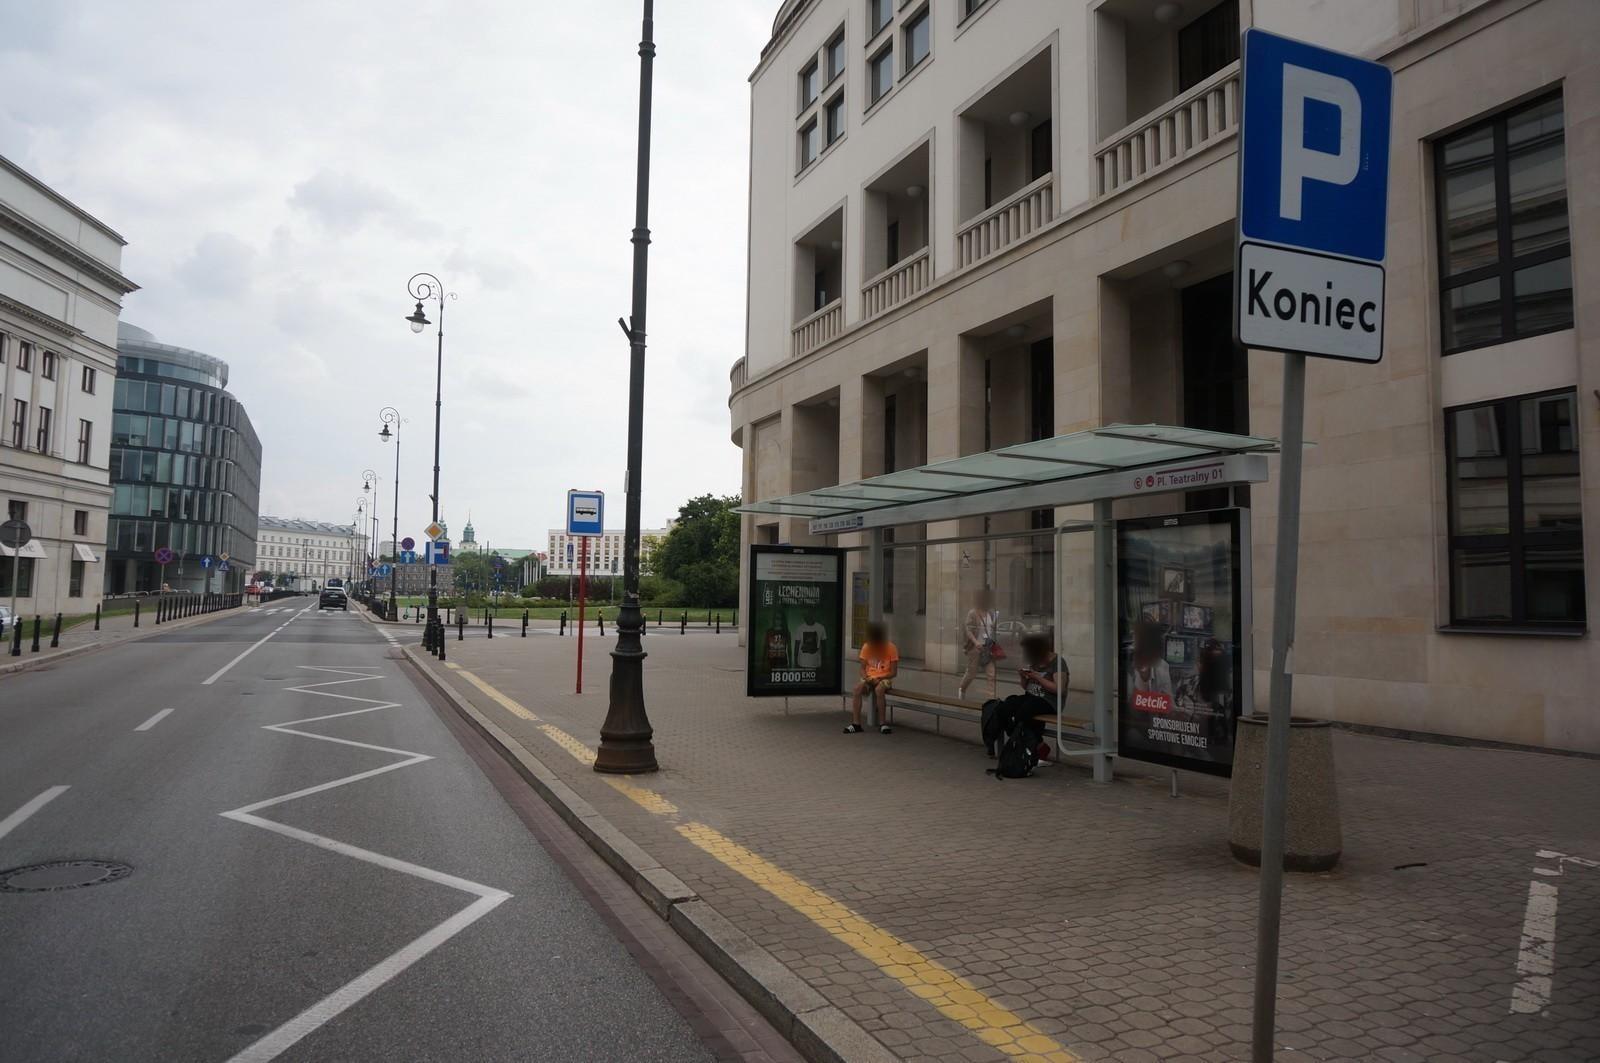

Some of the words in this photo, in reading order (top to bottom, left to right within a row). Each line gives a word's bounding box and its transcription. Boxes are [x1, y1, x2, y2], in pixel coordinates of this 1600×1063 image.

[1280, 62, 1362, 221] P
[1248, 268, 1376, 333] Koniec
[1157, 476, 1167, 487] Pl.
[1169, 471, 1210, 484] Teatralny
[1212, 469, 1223, 480] 01
[1135, 694, 1168, 710] Betclic
[1152, 717, 1200, 735] SPONSORUJEMY
[1147, 728, 1180, 744] SPORTOWE
[1180, 734, 1208, 749] EMOCJE!
